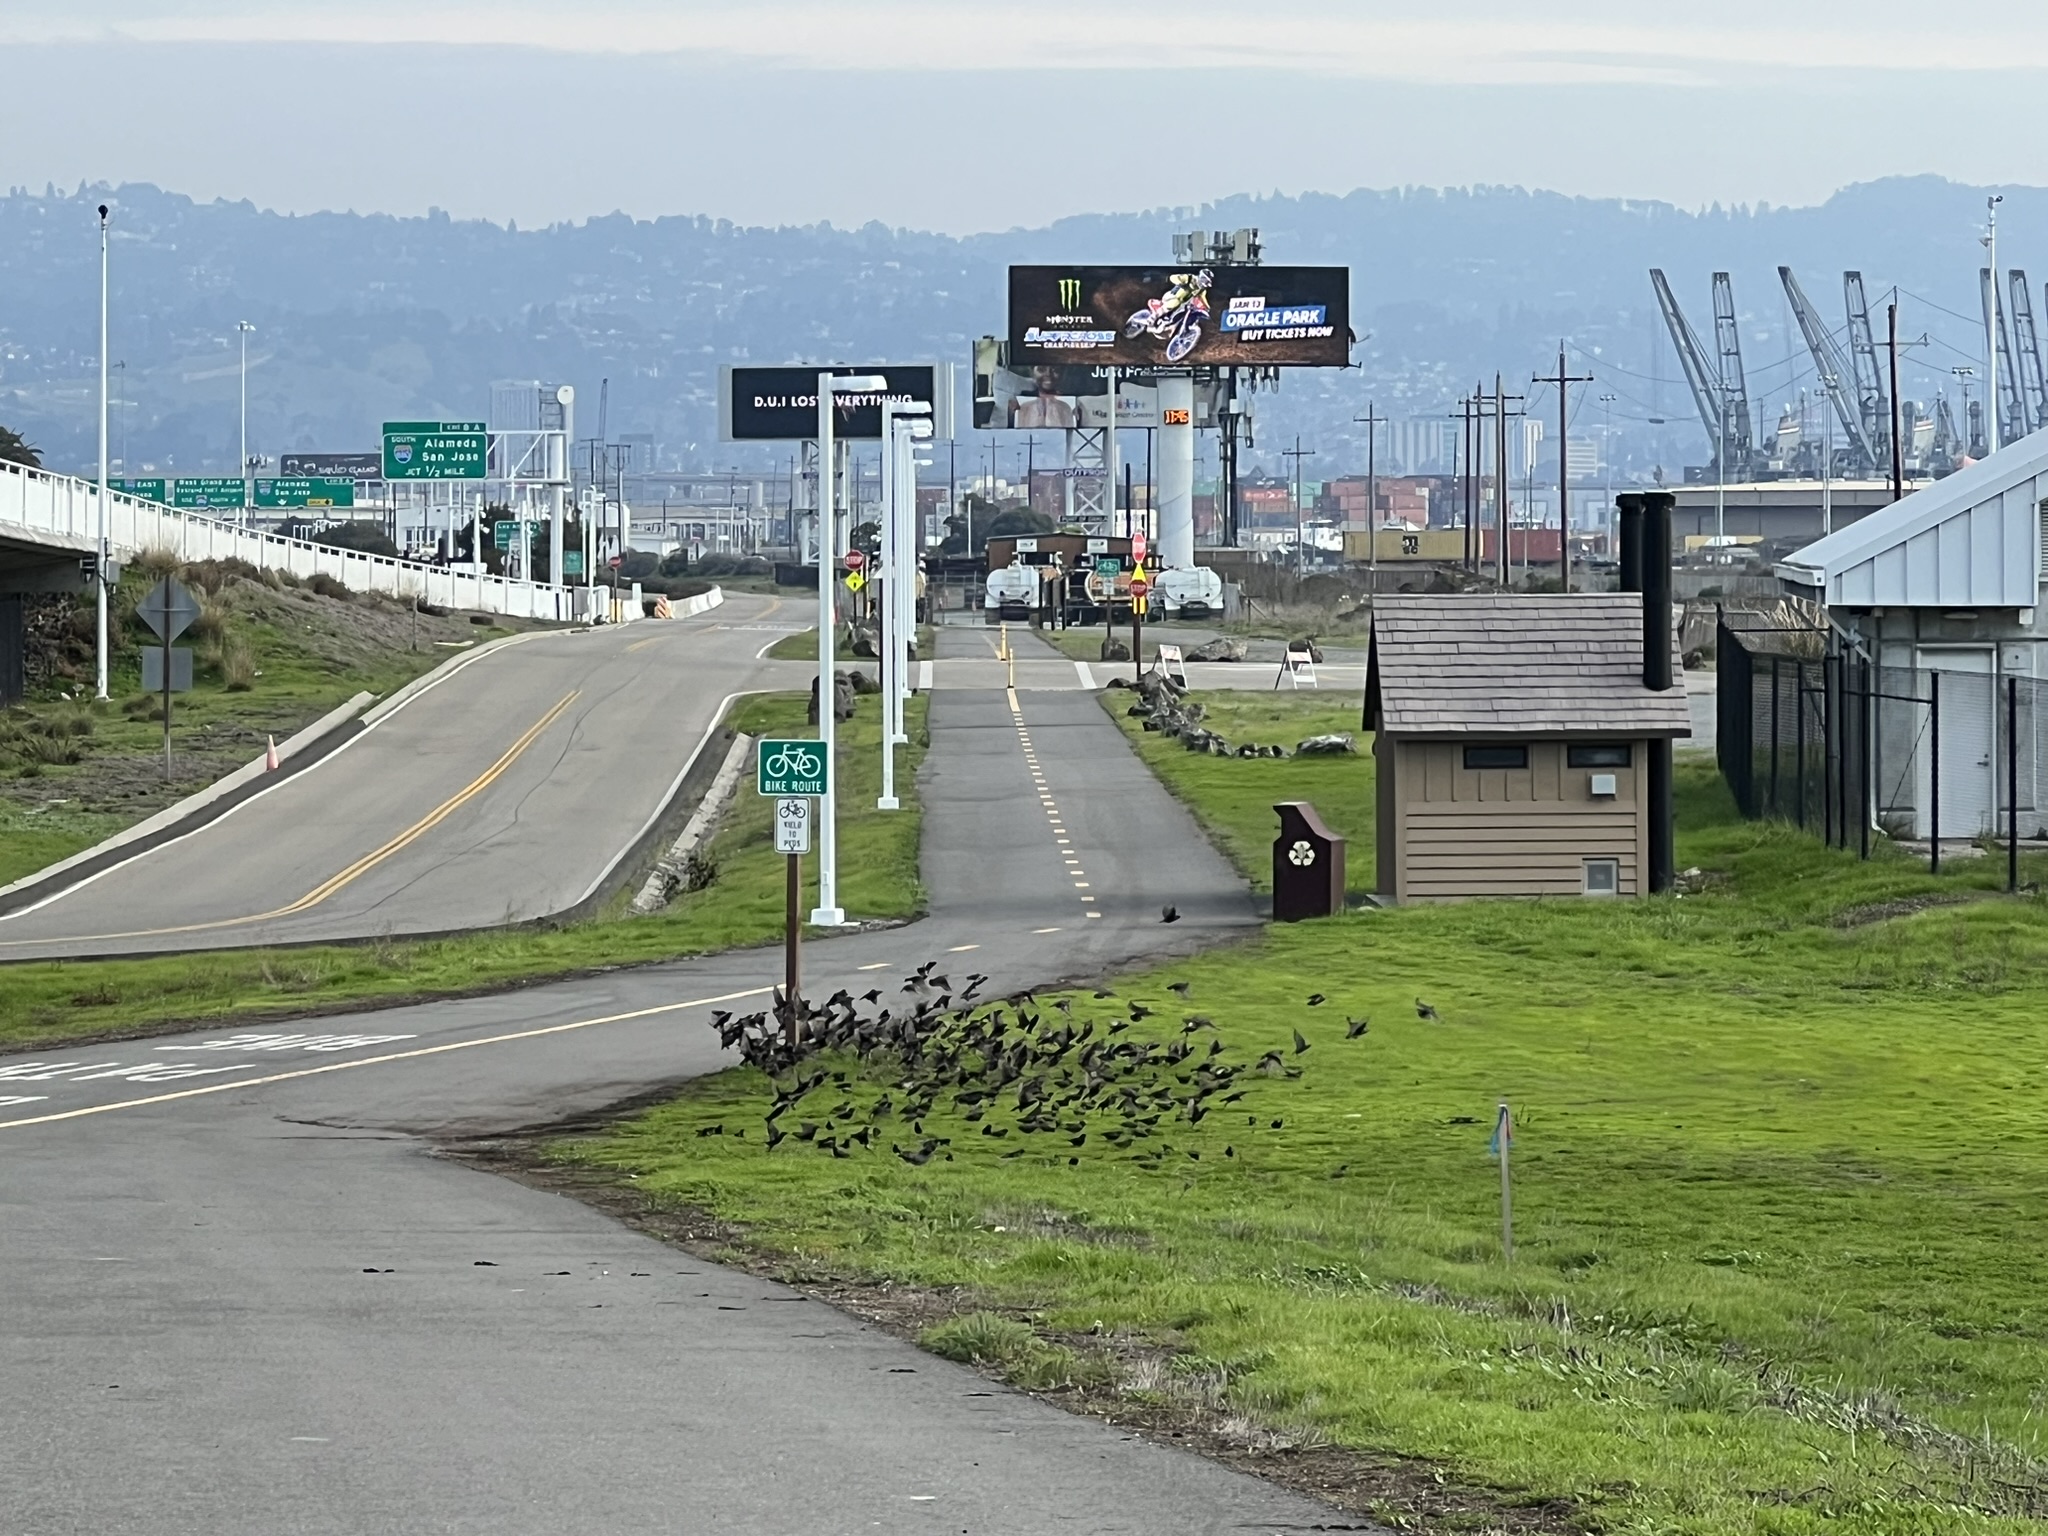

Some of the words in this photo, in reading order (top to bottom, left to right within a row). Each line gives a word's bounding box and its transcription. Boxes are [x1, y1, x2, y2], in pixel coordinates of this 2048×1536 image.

[1046, 315, 1093, 324] MONSTER
[1226, 312, 1280, 327] ORACLE
[1282, 309, 1320, 324] PARK
[1241, 330, 1264, 341] BUY
[1265, 328, 1306, 340] TICKETS
[1307, 326, 1334, 338] NOW
[791, 396, 820, 407] LOS
[833, 395, 912, 406] VERYTHING
[425, 439, 477, 448] Alameda
[422, 452, 445, 462] San
[451, 452, 478, 461] Jose
[405, 468, 421, 476] JCT
[765, 781, 787, 792] BIKE
[791, 781, 822, 792] ROUTE
[784, 821, 802, 829] YIELD
[789, 830, 797, 838] TO
